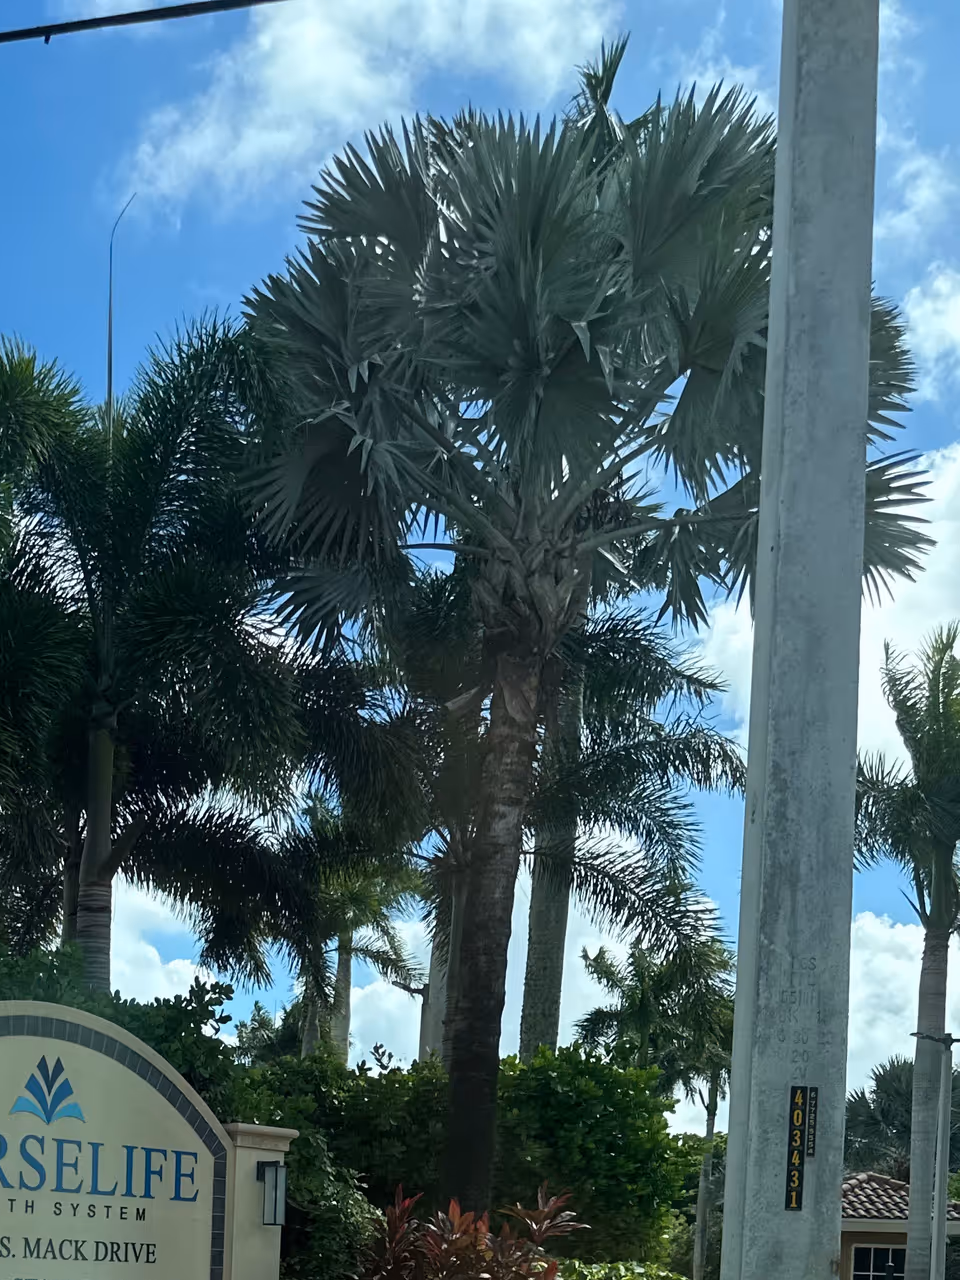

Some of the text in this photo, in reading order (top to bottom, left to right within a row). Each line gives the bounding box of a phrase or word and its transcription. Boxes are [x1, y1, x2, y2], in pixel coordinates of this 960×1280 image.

[789, 1088, 804, 1208] 403431
[53, 1201, 147, 1222] SYSTEM
[0, 1236, 17, 1259] S.
[22, 1237, 88, 1262] MACK
[93, 1240, 157, 1264] DRIVE
